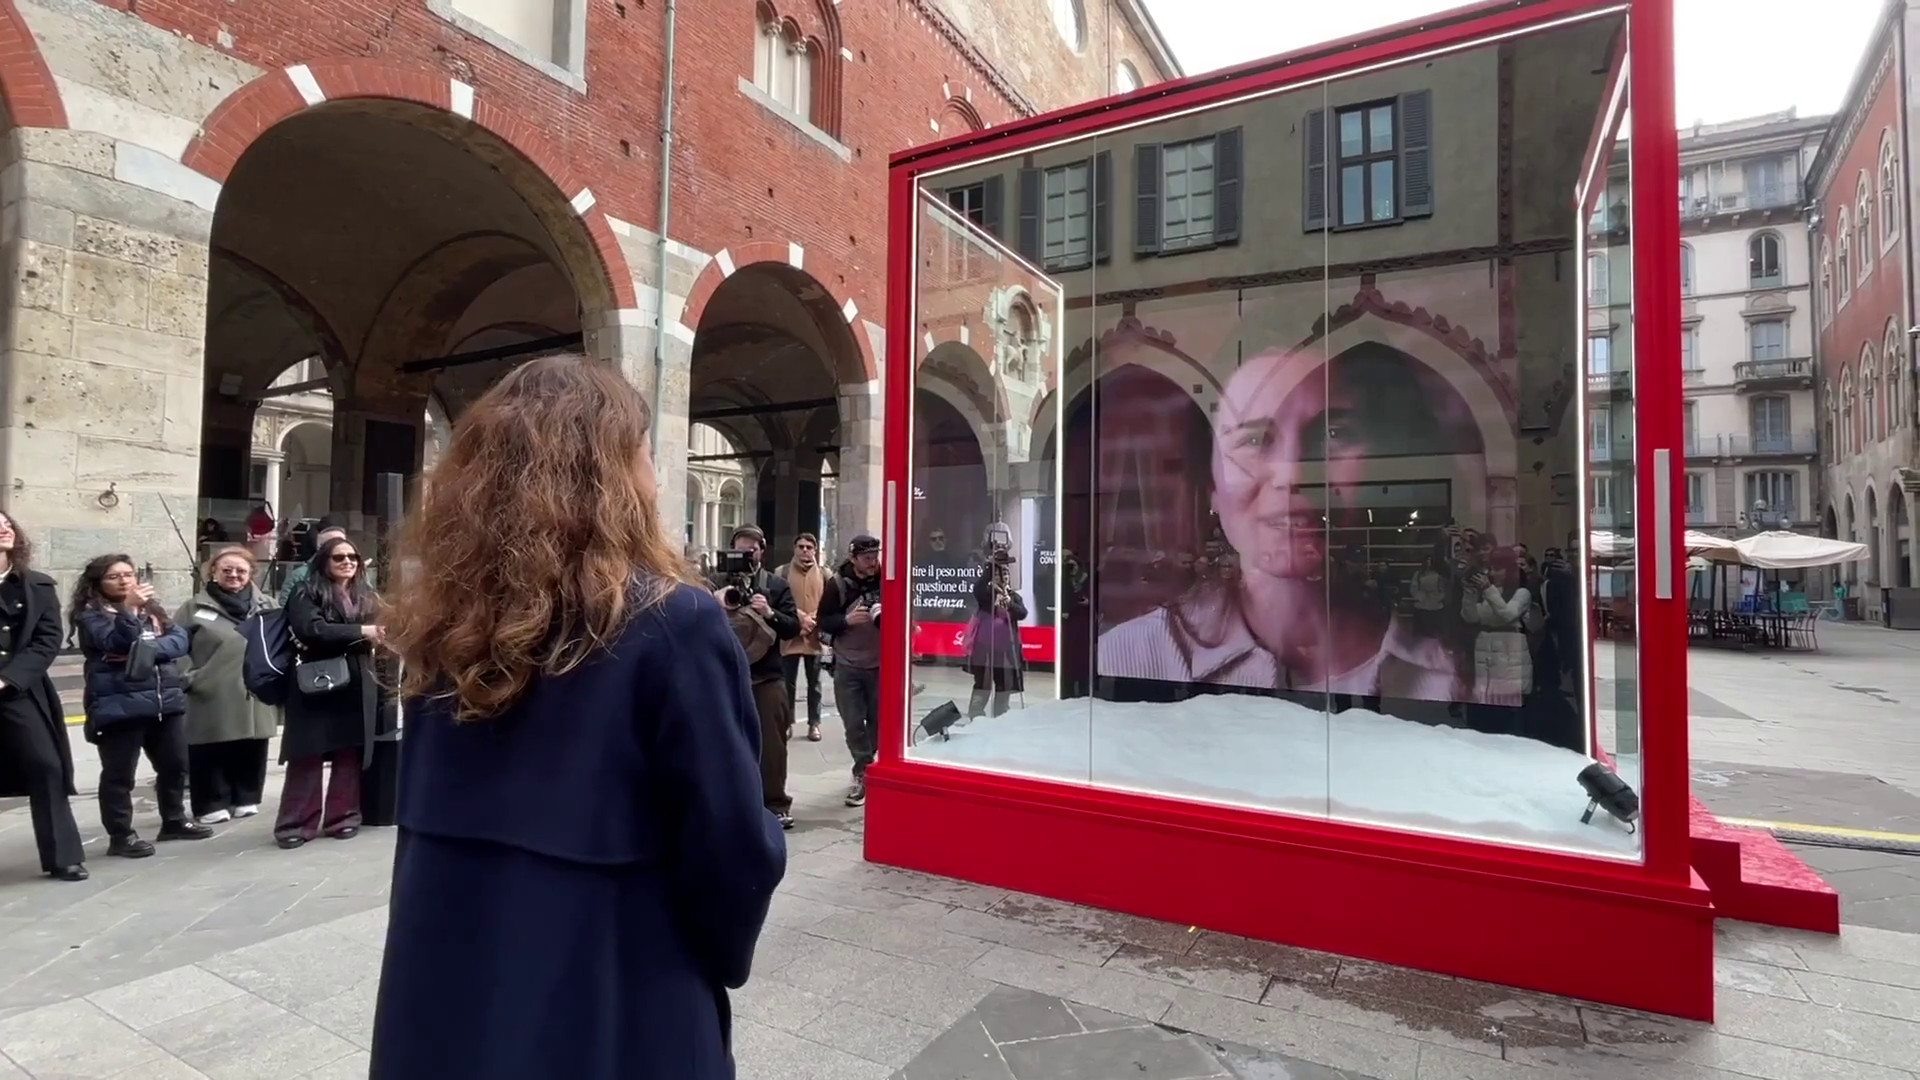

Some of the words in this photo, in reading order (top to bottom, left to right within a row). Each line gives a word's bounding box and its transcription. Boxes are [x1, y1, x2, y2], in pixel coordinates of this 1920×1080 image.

[928, 564, 934, 577] il
[935, 566, 956, 580] peso
[957, 567, 976, 577] non
[977, 564, 984, 577] è
[916, 580, 957, 594] questione
[958, 580, 967, 592] di
[913, 594, 922, 607] di
[922, 595, 967, 608] scienza.
